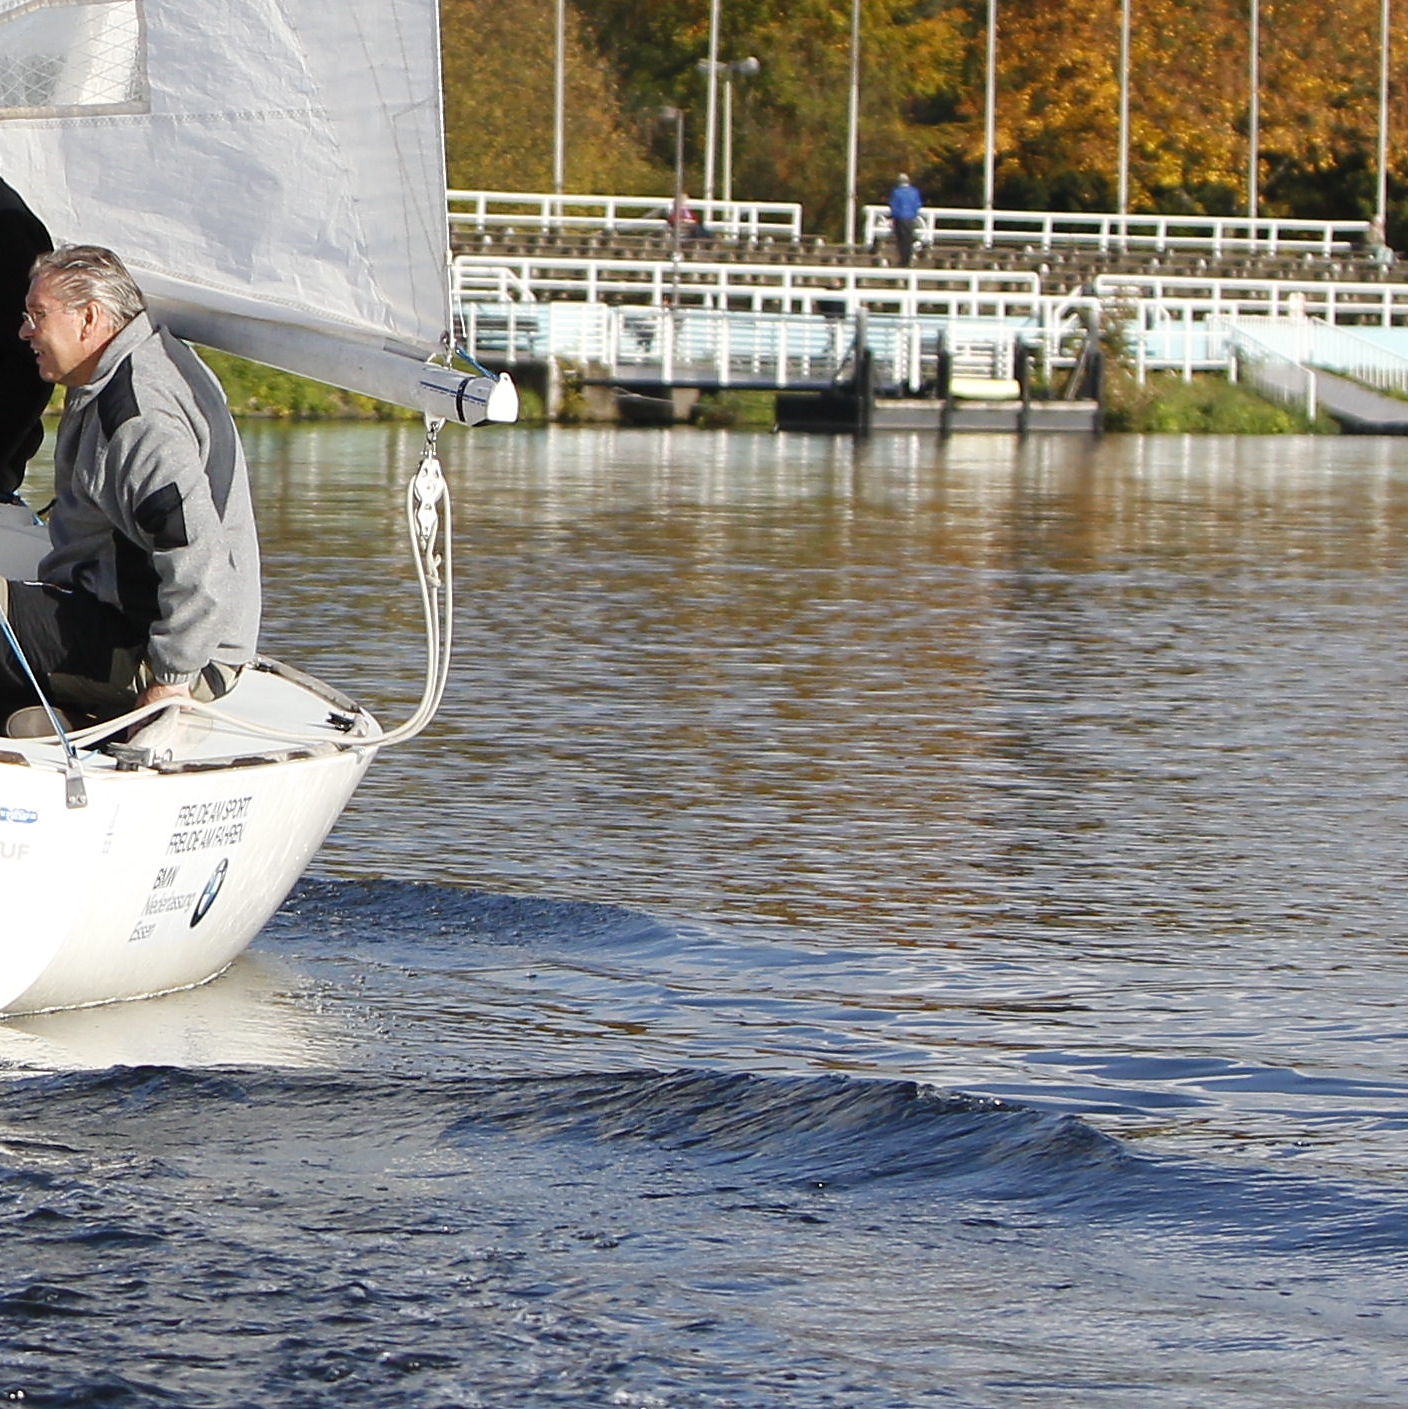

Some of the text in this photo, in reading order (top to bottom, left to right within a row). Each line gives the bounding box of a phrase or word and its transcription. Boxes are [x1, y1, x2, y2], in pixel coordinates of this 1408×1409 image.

[175, 804, 213, 827] FREUDE
[166, 829, 203, 855] FREUDE
[152, 865, 181, 890] BMW
